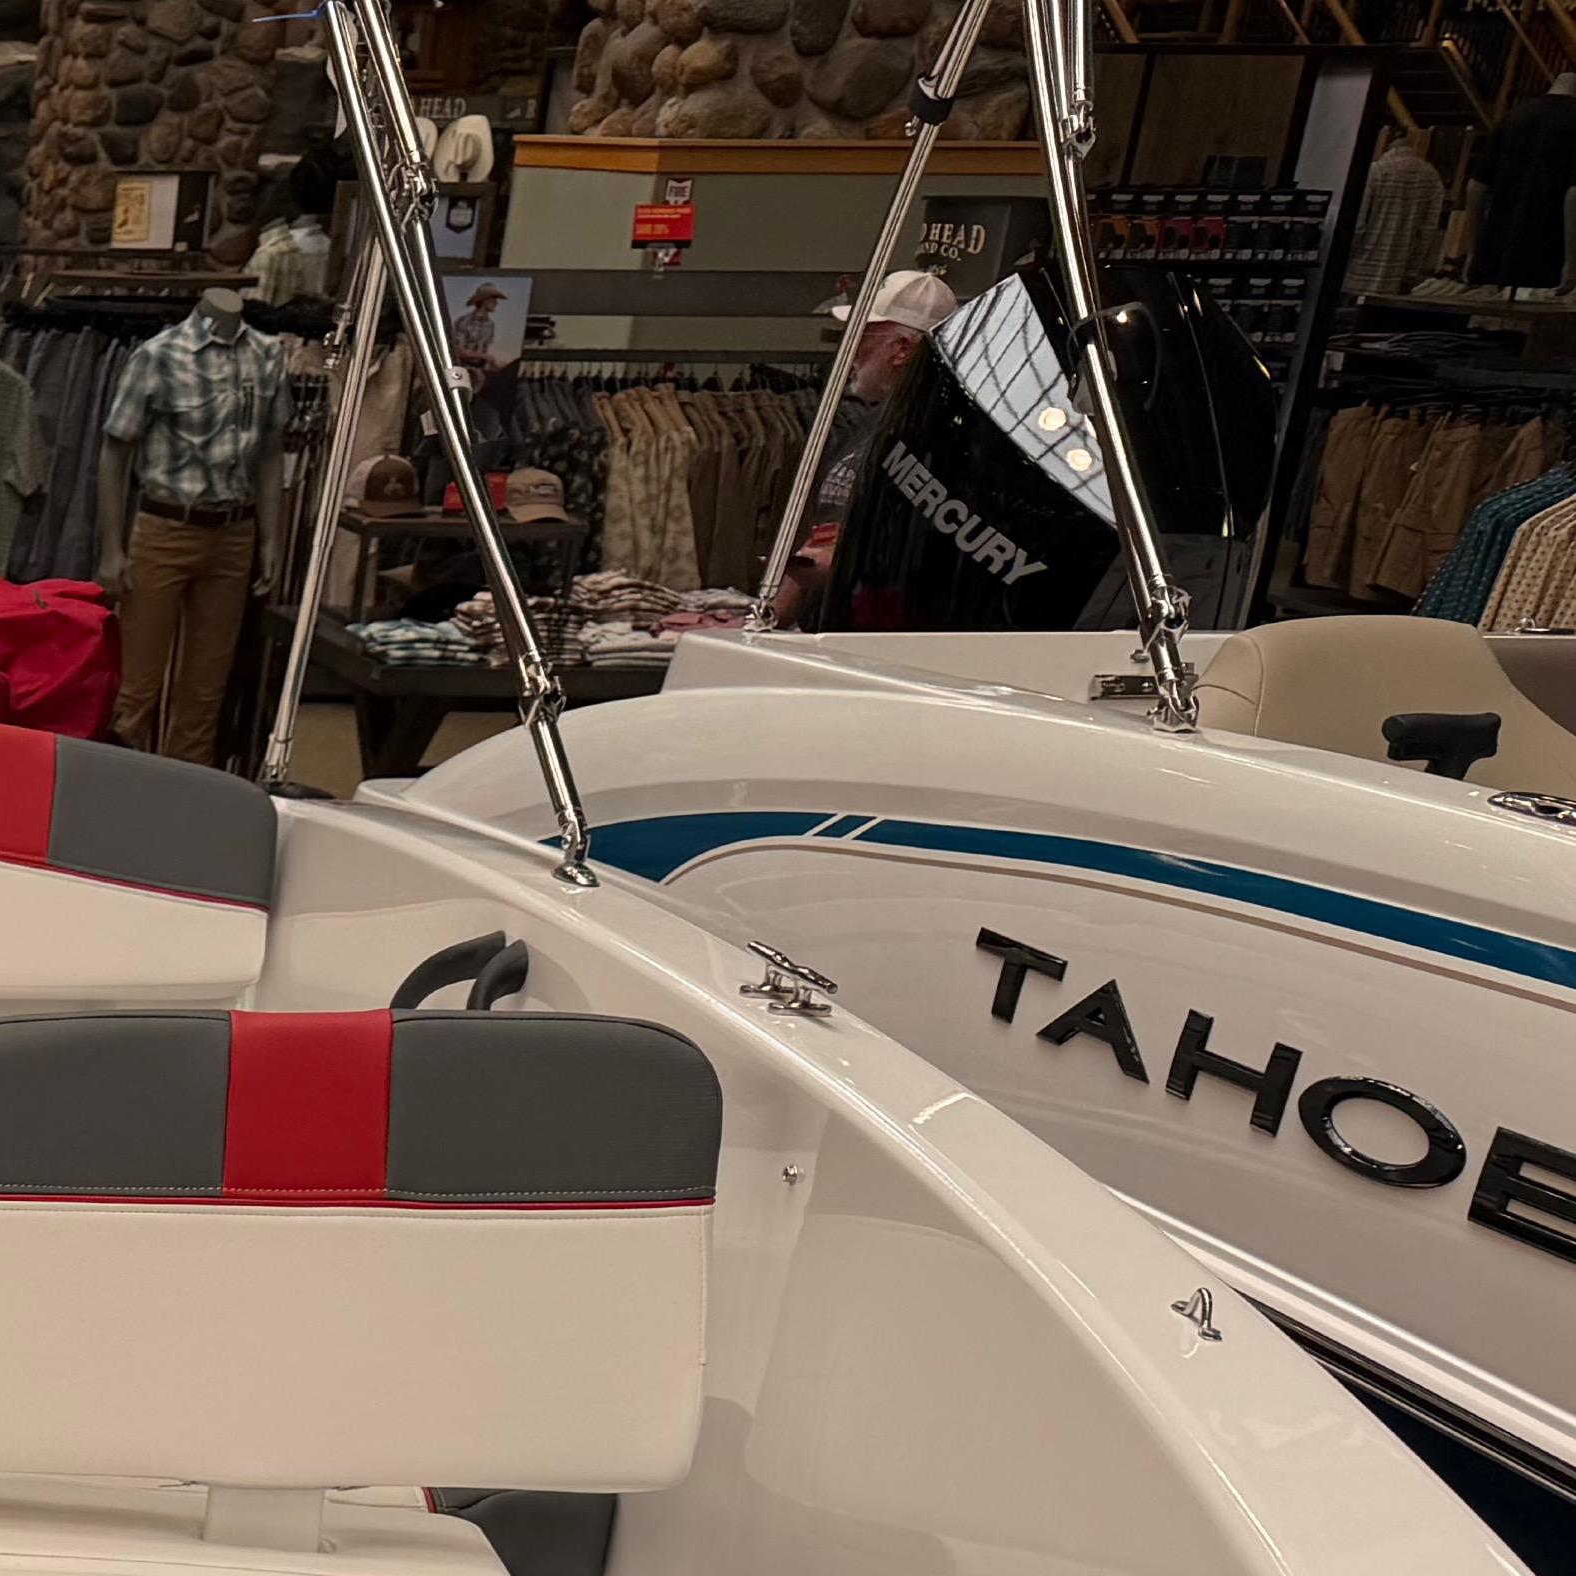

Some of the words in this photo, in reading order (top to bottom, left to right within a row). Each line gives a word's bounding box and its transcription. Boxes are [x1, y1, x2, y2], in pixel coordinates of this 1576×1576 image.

[940, 244, 962, 262] CO.
[882, 440, 1049, 586] MERCURY
[976, 927, 1576, 1264] TAHOE
